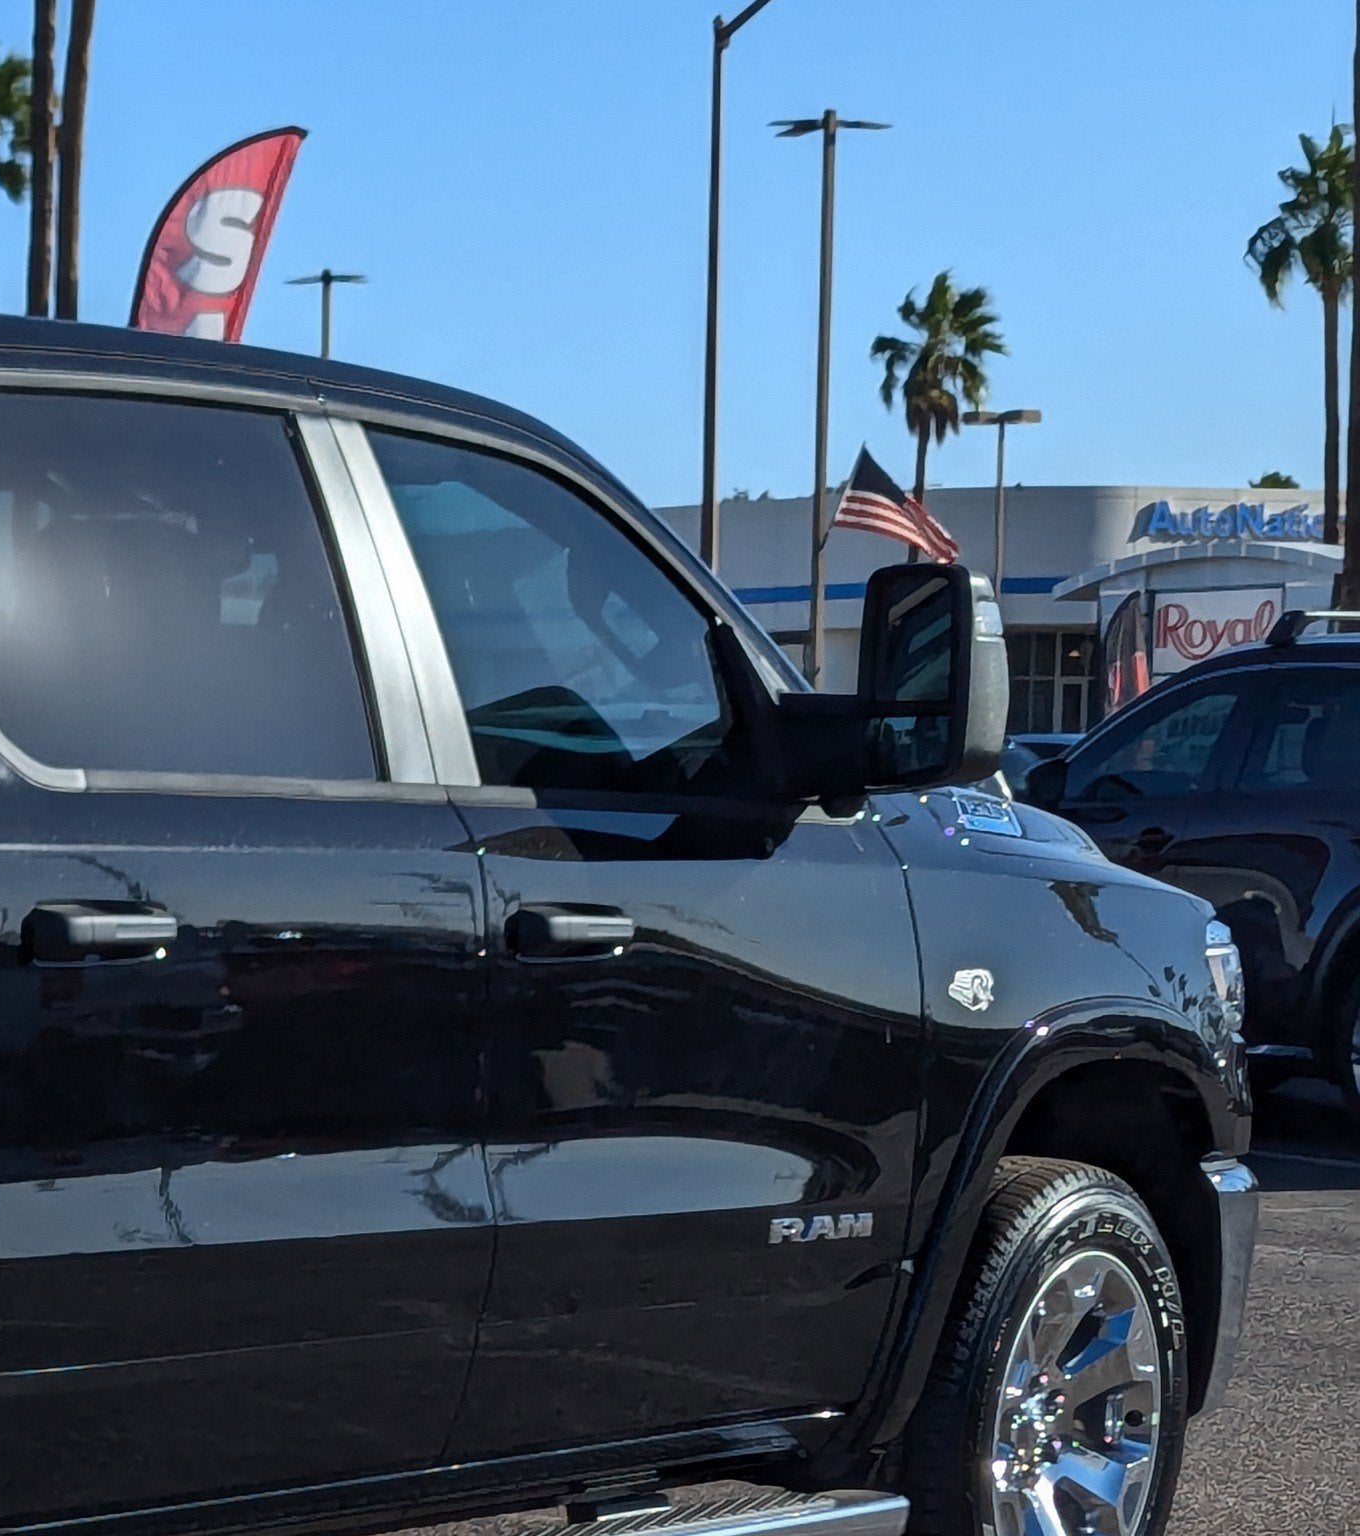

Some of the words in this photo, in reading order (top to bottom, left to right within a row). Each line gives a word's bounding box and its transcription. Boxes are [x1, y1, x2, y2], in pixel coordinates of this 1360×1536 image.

[1148, 500, 1342, 538] AutoNatio
[1154, 600, 1275, 660] Royal
[768, 1212, 873, 1244] RAM
